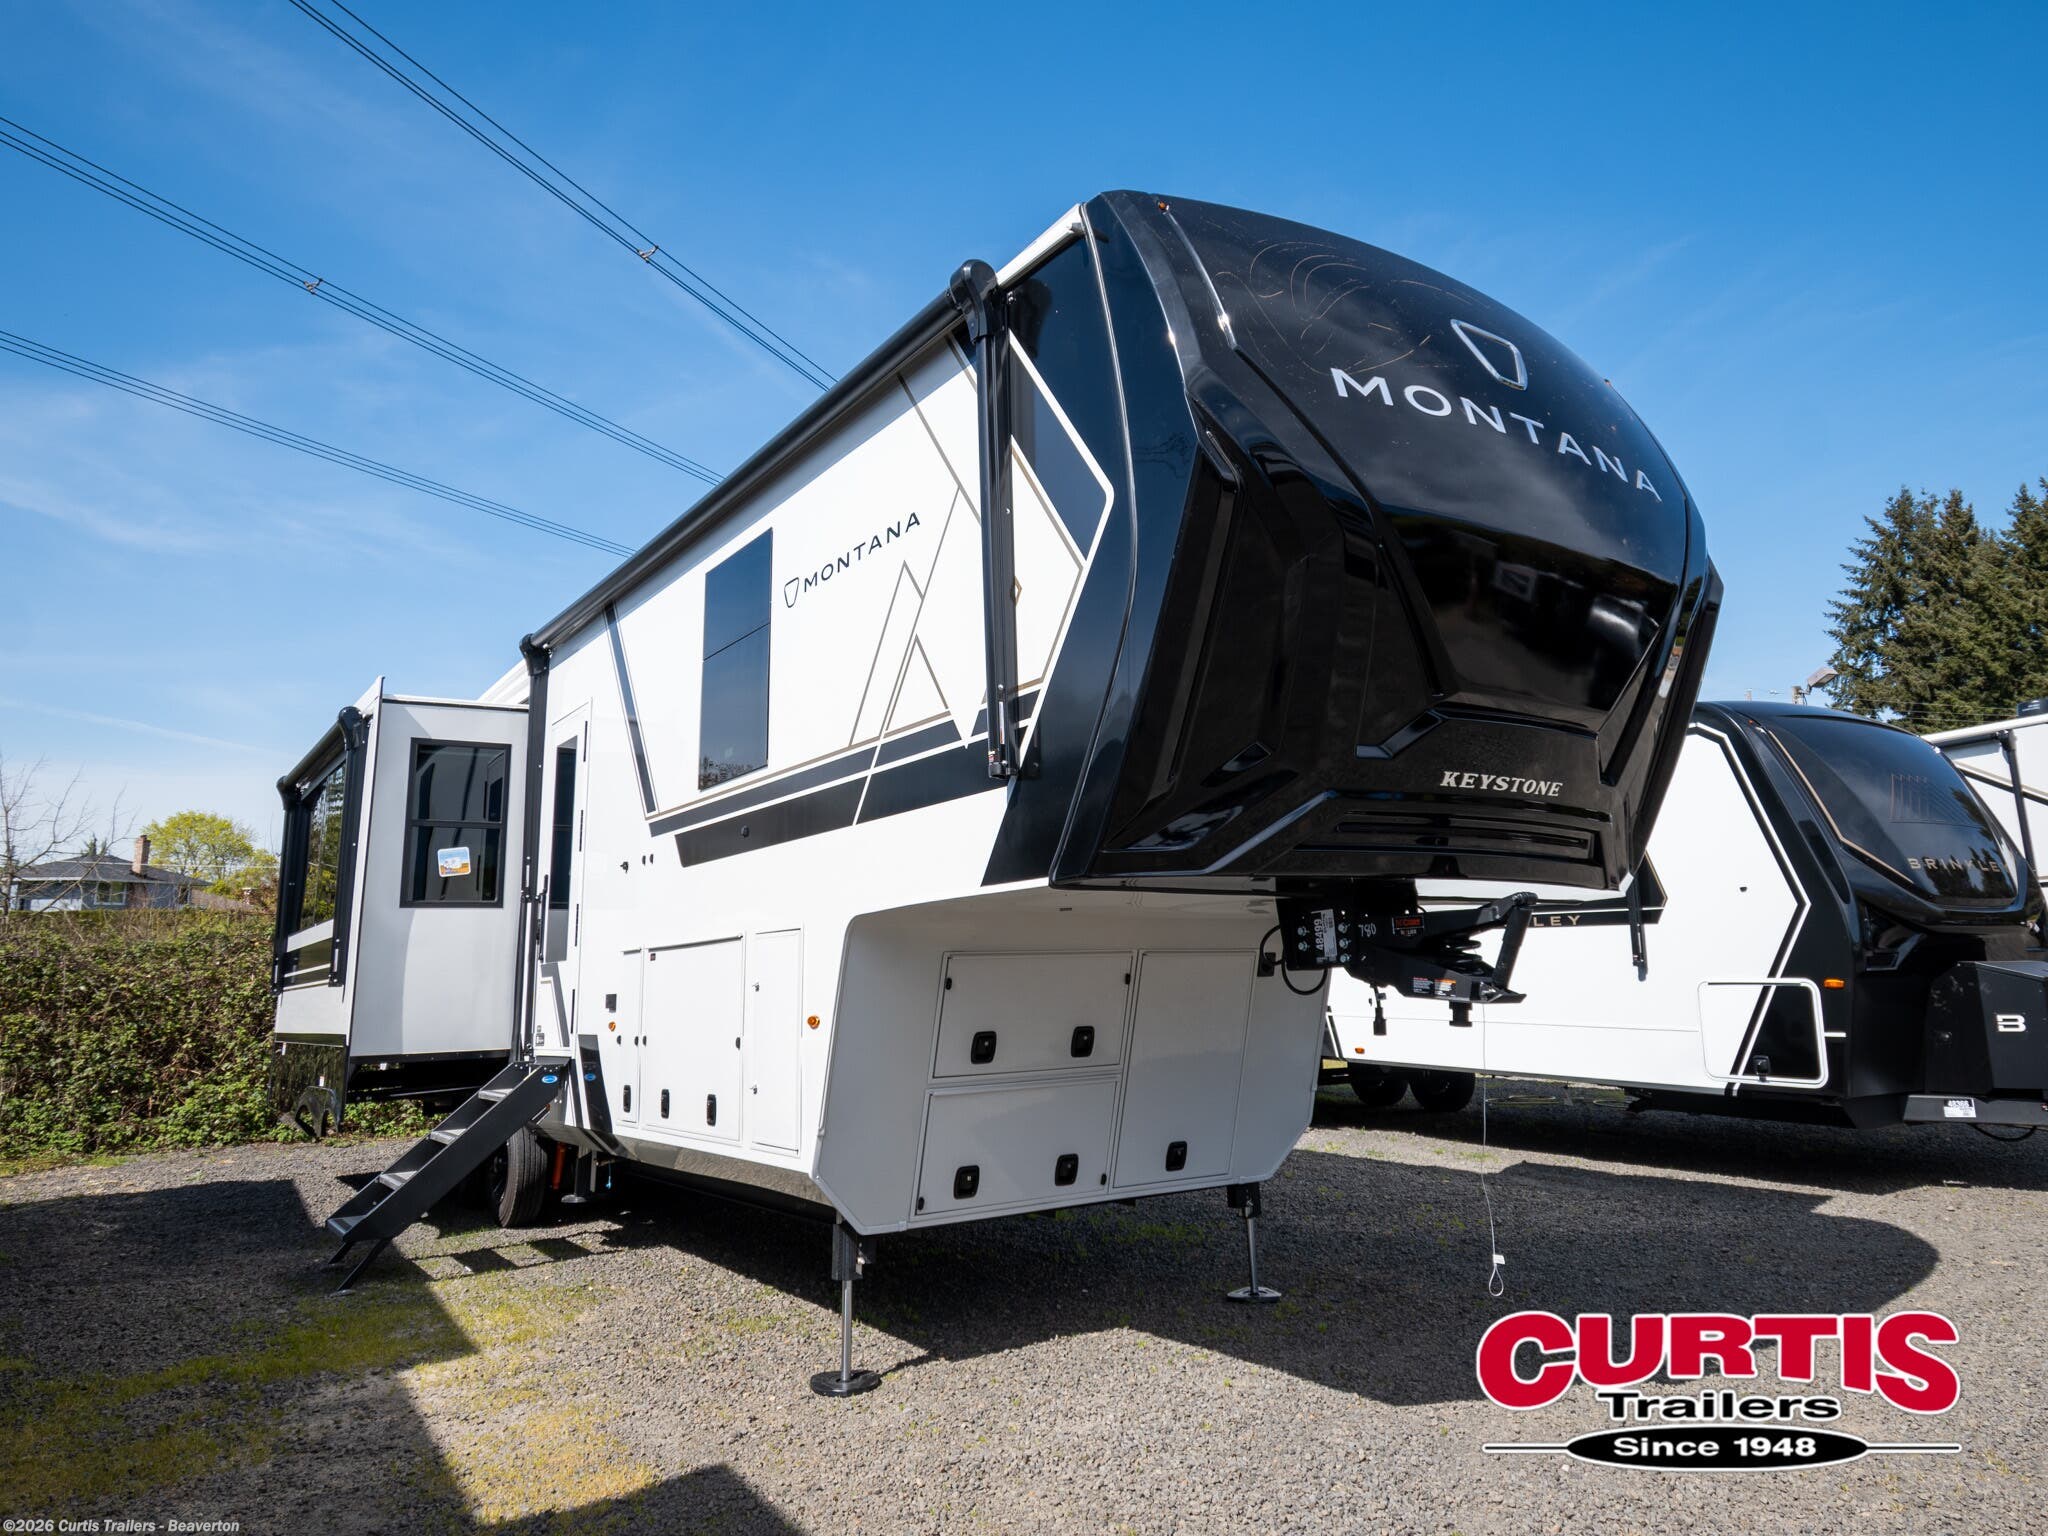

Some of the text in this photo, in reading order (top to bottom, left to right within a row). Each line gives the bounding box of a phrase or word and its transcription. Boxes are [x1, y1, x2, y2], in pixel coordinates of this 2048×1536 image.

[1330, 367, 1662, 502] MONTANA
[804, 512, 921, 593] MONTANA
[1440, 771, 1563, 797] KEYSTONE
[1907, 857, 2004, 873] BRINKLE
[1314, 919, 1324, 950] 48499
[1996, 1014, 2026, 1032] B
